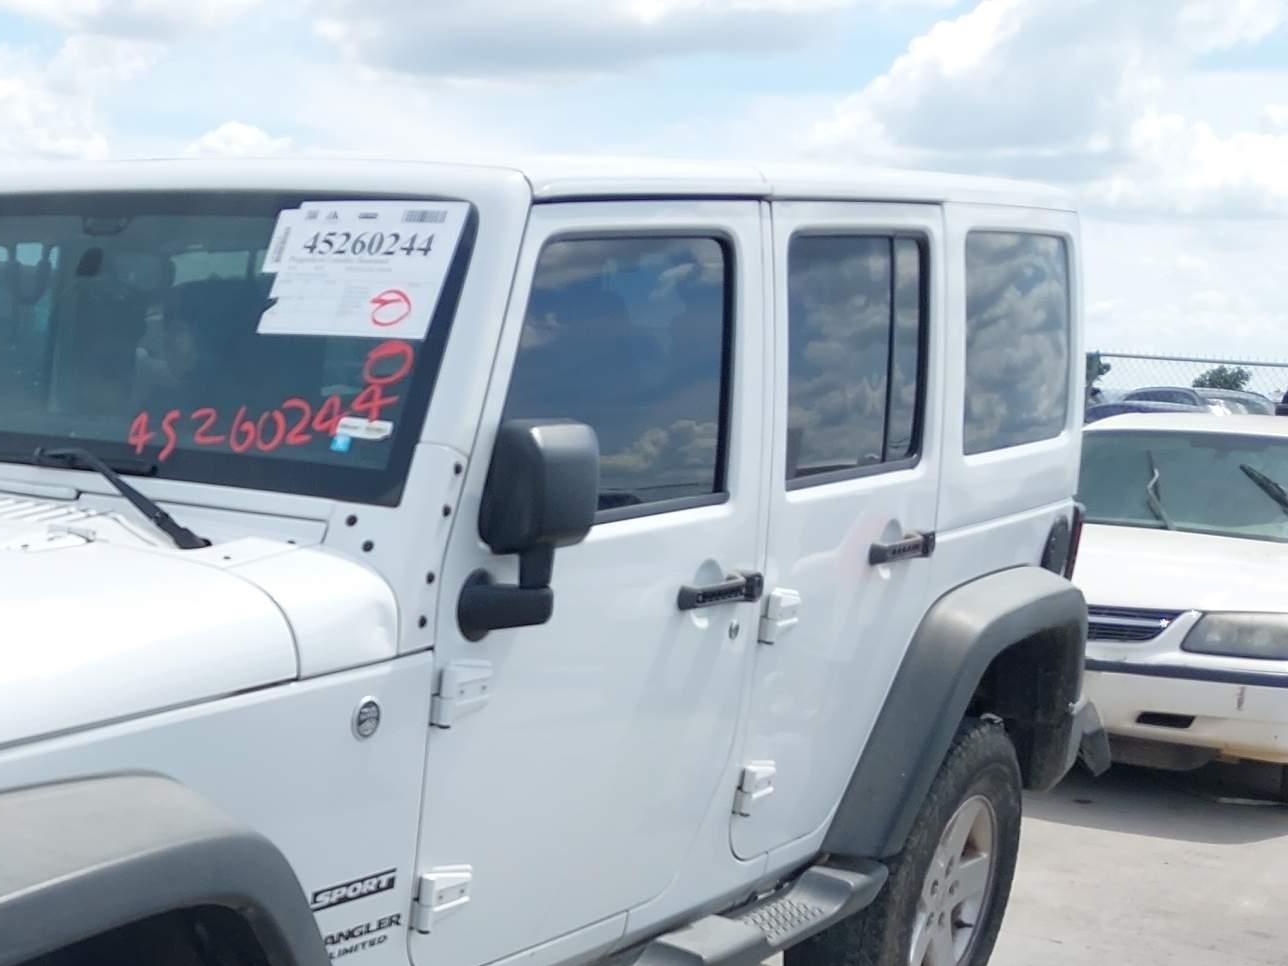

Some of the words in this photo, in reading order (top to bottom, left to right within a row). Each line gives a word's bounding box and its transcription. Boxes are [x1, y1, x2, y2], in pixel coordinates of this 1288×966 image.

[303, 231, 436, 257] 45260244
[313, 874, 395, 908] SPORT
[324, 913, 402, 946] ANGLER
[328, 934, 388, 960] LIMITED
